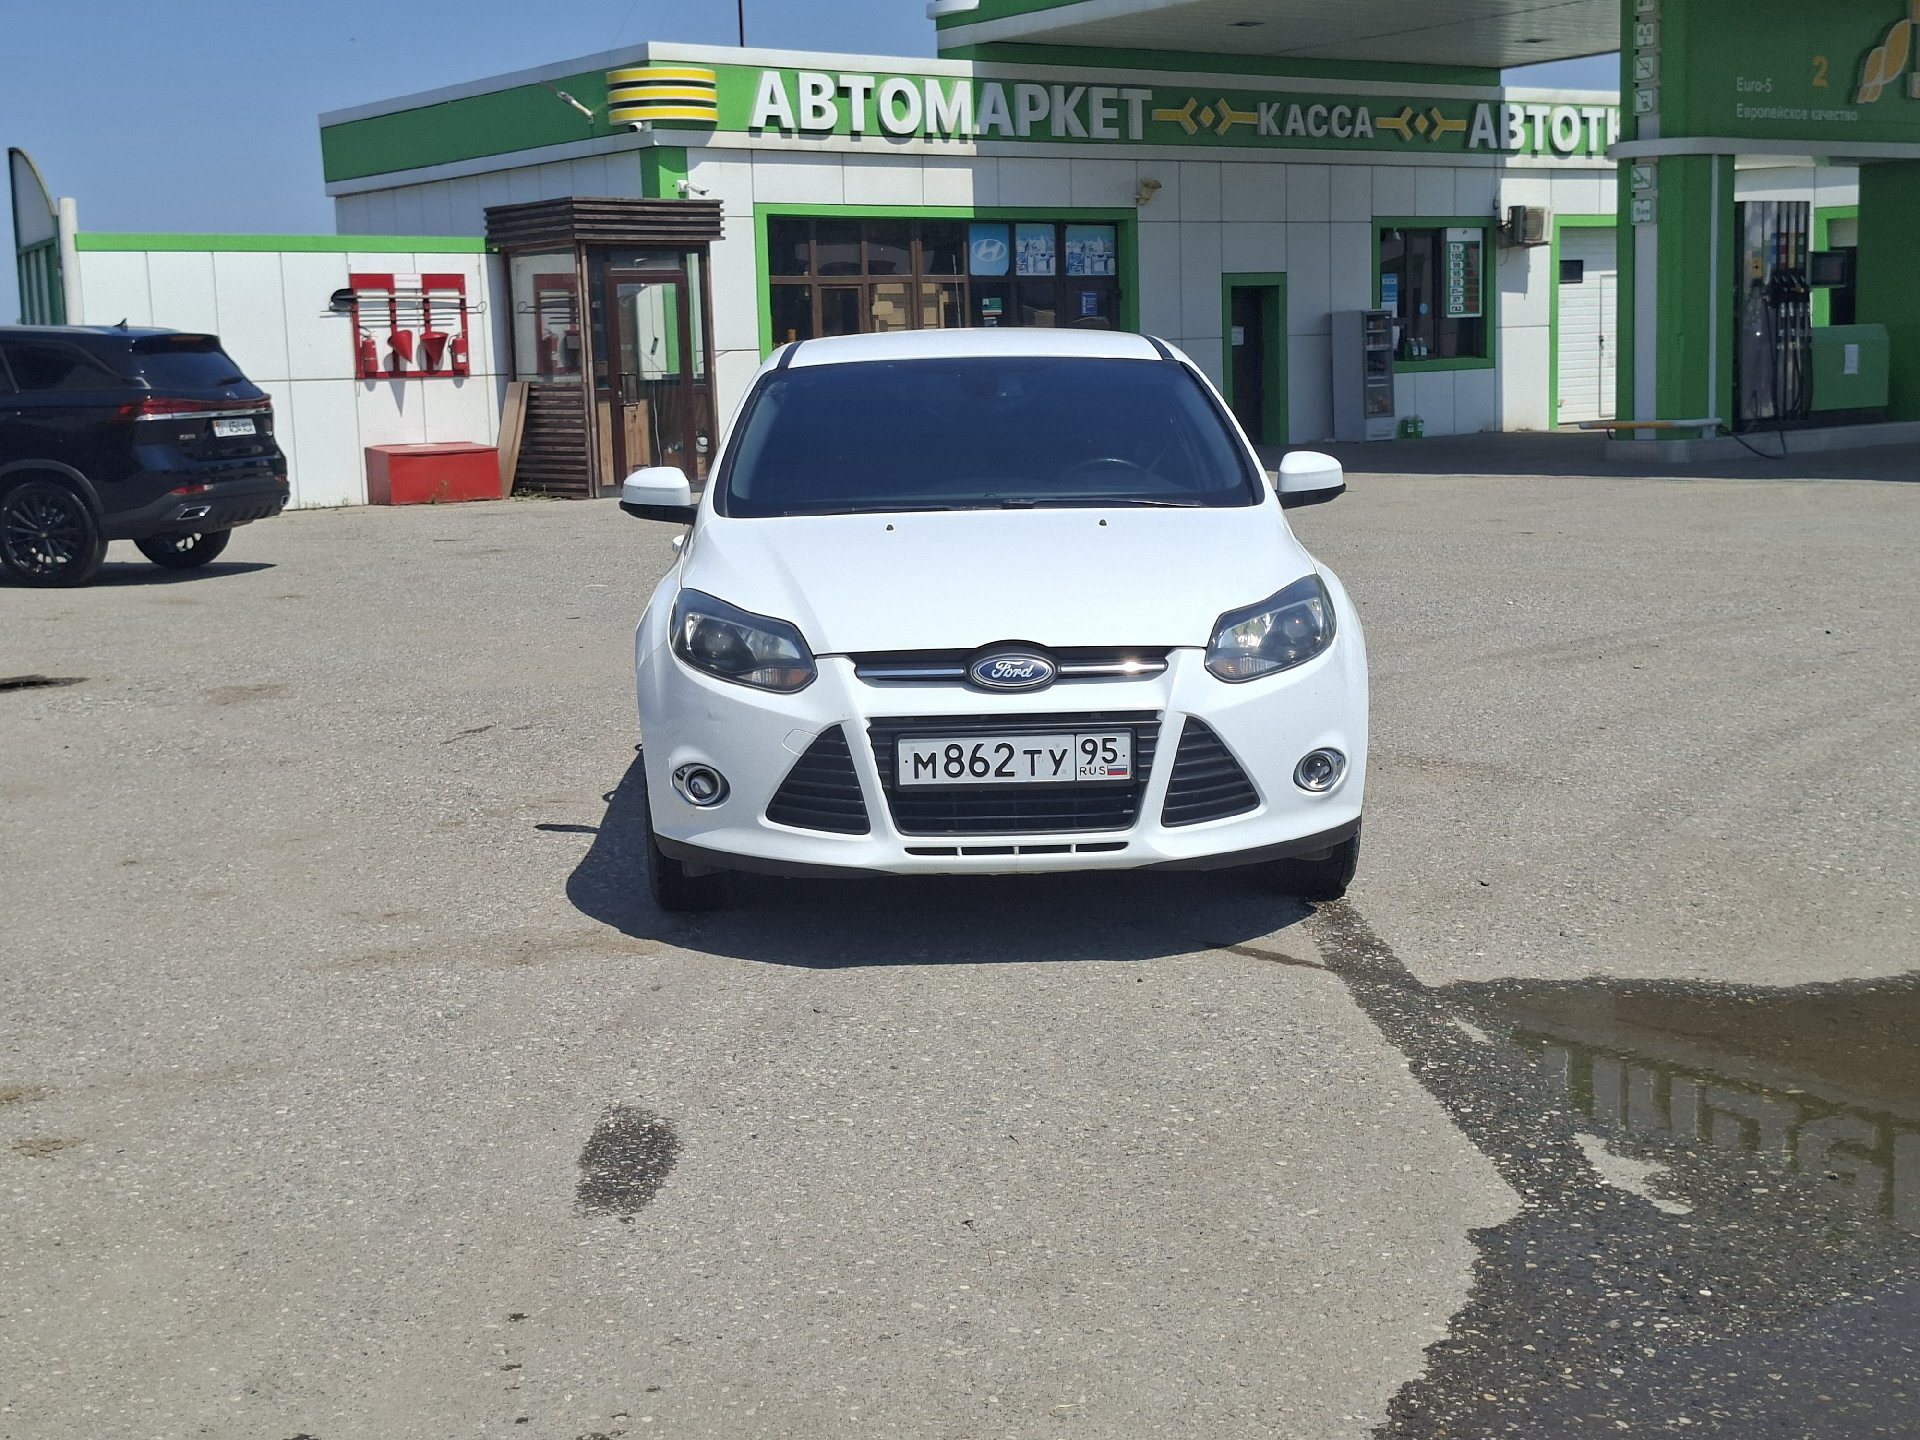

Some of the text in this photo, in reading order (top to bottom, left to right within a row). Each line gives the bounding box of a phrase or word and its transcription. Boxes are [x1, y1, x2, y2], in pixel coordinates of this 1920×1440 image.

[1812, 55, 1829, 88] 2
[1736, 76, 1773, 93] Euro-5
[750, 69, 1154, 140] АВТОМАРКЕТ
[1257, 102, 1375, 138] КАССА
[1810, 110, 1859, 122] качество
[991, 660, 1034, 679] Ford
[913, 737, 1118, 779] М862ТУ 95
[1079, 766, 1106, 776] RUS
